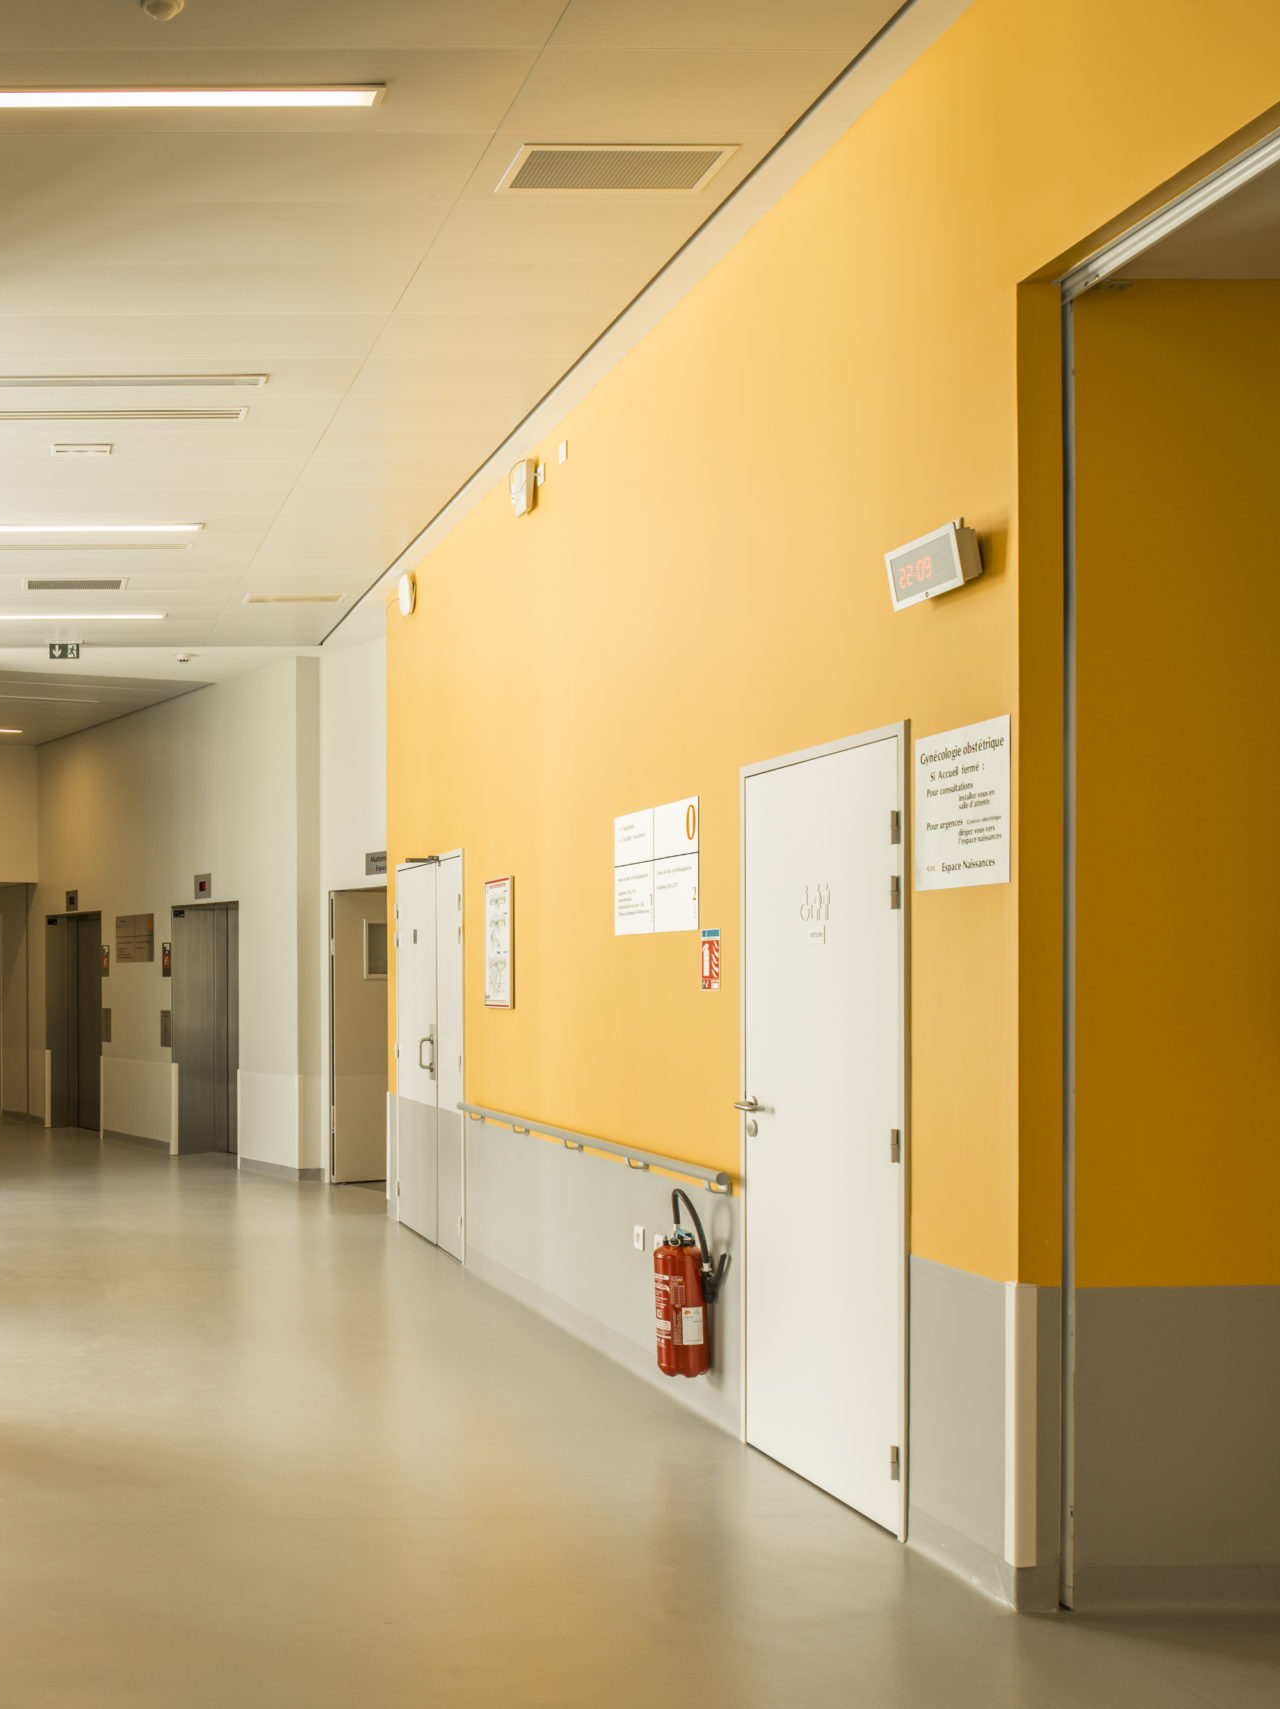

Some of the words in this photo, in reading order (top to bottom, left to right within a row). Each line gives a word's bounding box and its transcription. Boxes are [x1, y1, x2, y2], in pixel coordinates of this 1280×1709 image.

[920, 744, 962, 766] Gynécologie
[963, 736, 1004, 755] obstétrique
[938, 765, 959, 780] Accueil
[926, 788, 938, 798] Pour
[686, 804, 696, 840] 0
[926, 822, 939, 832] Pour
[941, 862, 962, 874] Espace
[962, 858, 996, 869] Naissances
